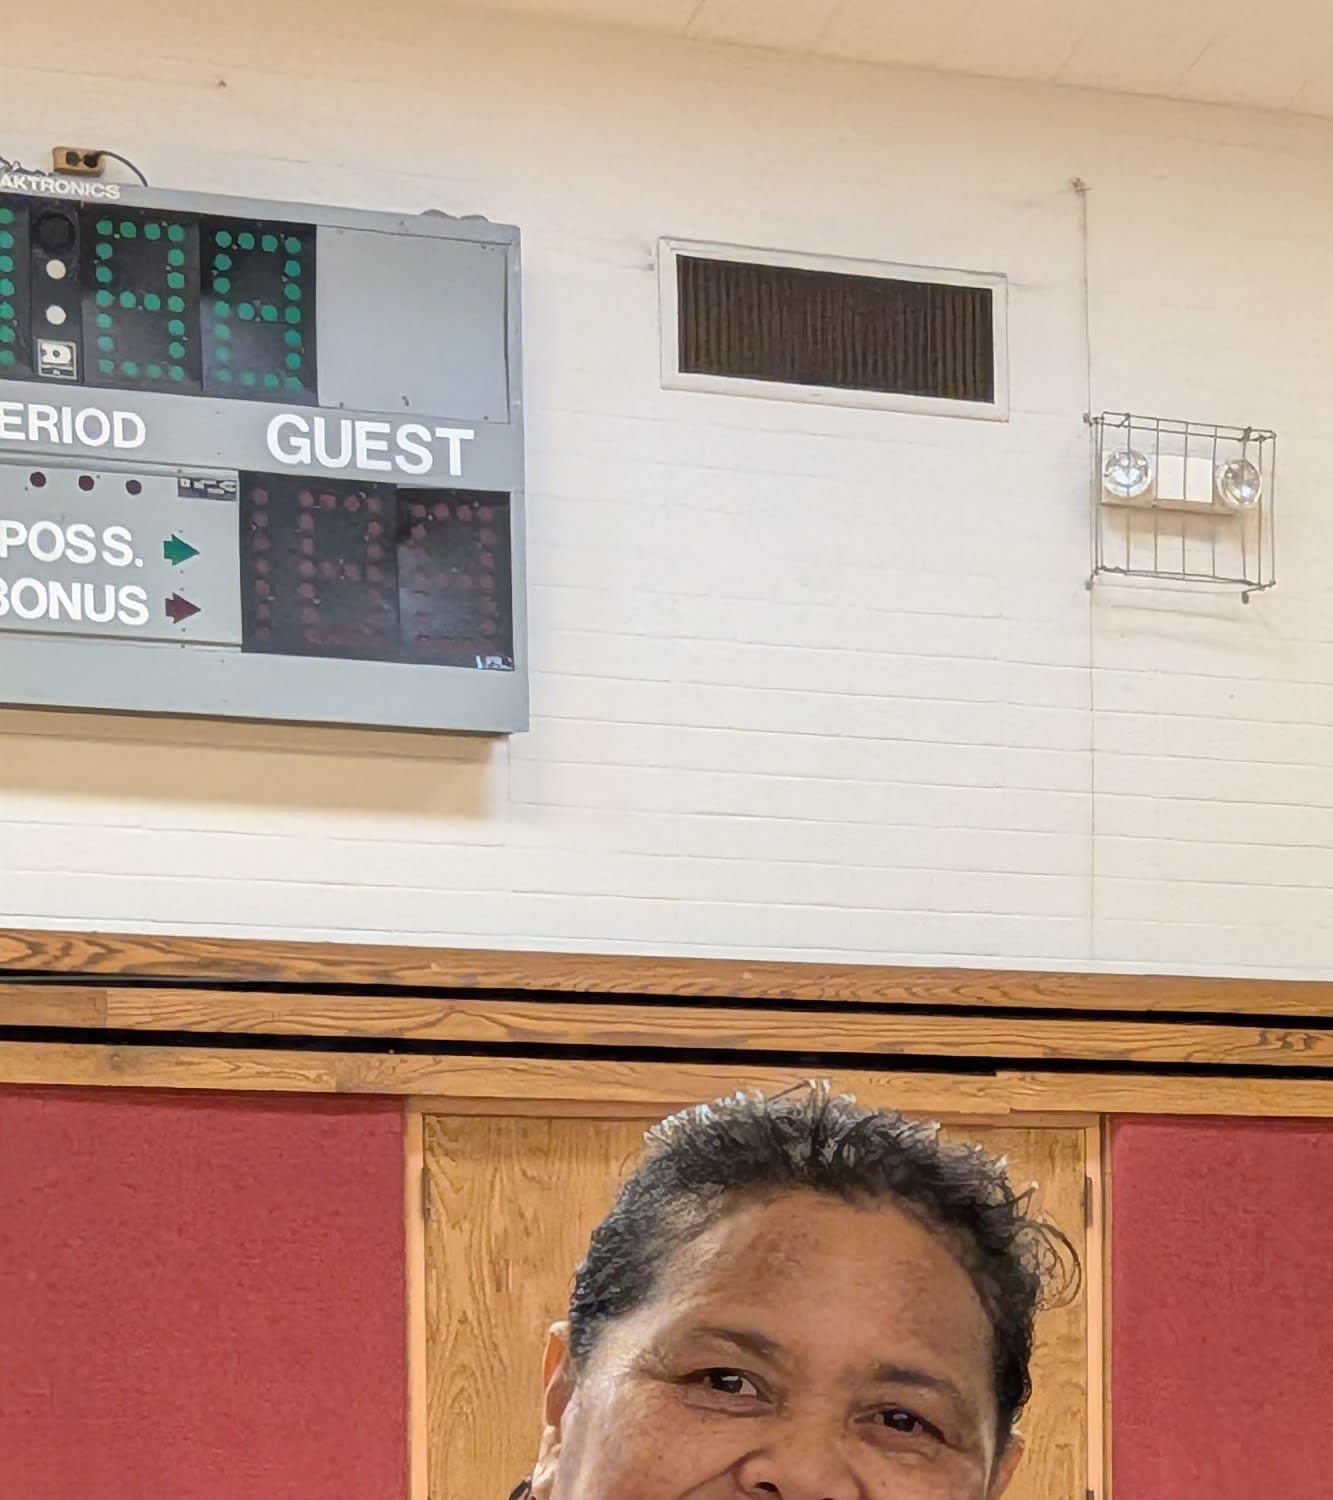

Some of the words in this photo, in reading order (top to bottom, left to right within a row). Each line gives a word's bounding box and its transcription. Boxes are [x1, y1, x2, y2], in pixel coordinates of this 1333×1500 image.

[0, 174, 121, 200] AKTRONICS
[0, 401, 147, 449] ERIOD
[266, 413, 475, 476] GUEST
[0, 519, 144, 568] POSS.
